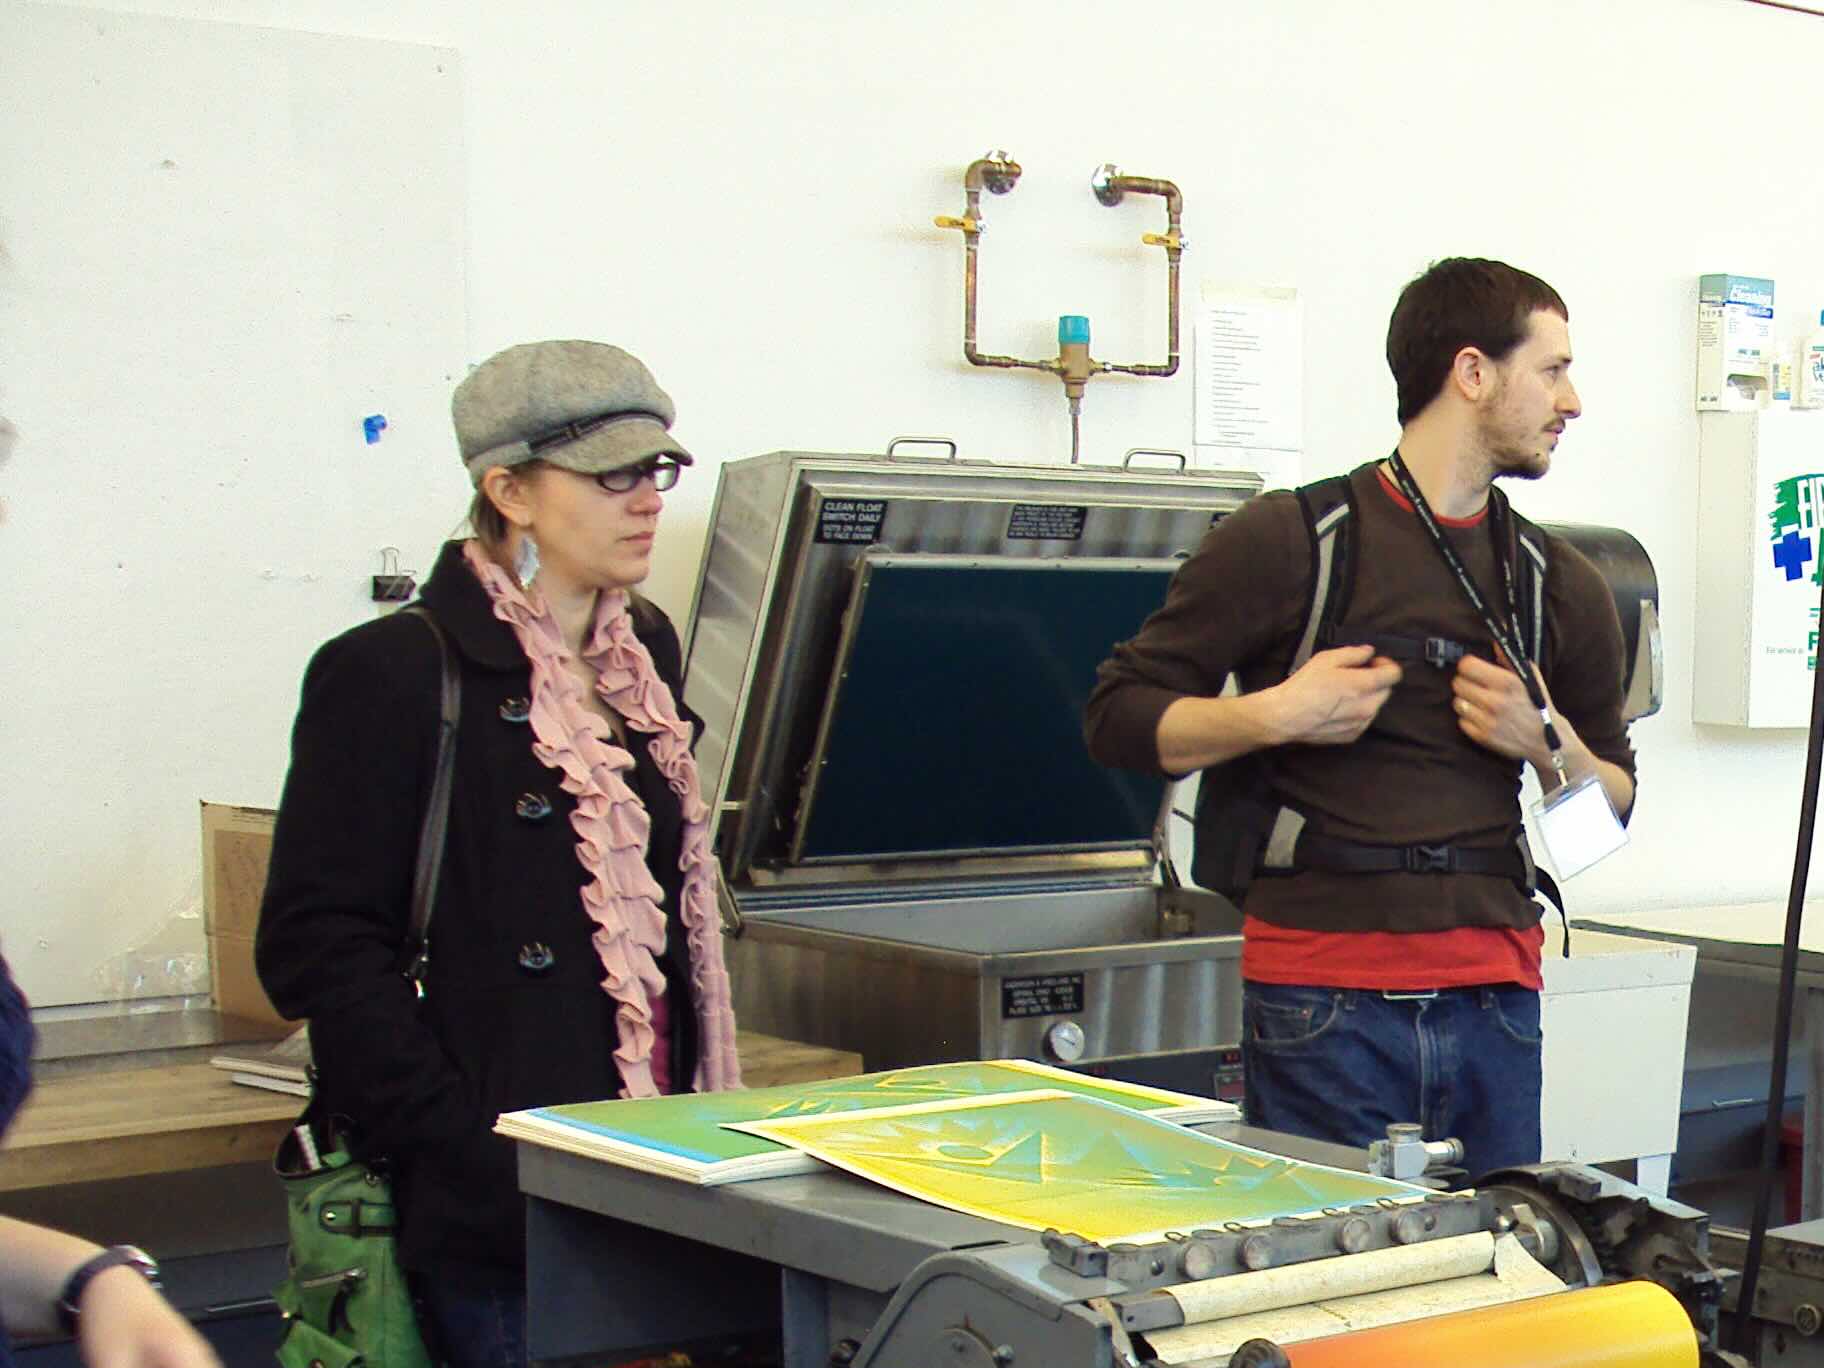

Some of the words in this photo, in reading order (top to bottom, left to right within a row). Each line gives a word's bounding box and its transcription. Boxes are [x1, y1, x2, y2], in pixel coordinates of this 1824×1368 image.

[824, 502, 854, 511] CLEAN
[856, 503, 883, 512] FLOAT
[858, 513, 880, 522] DAILY
